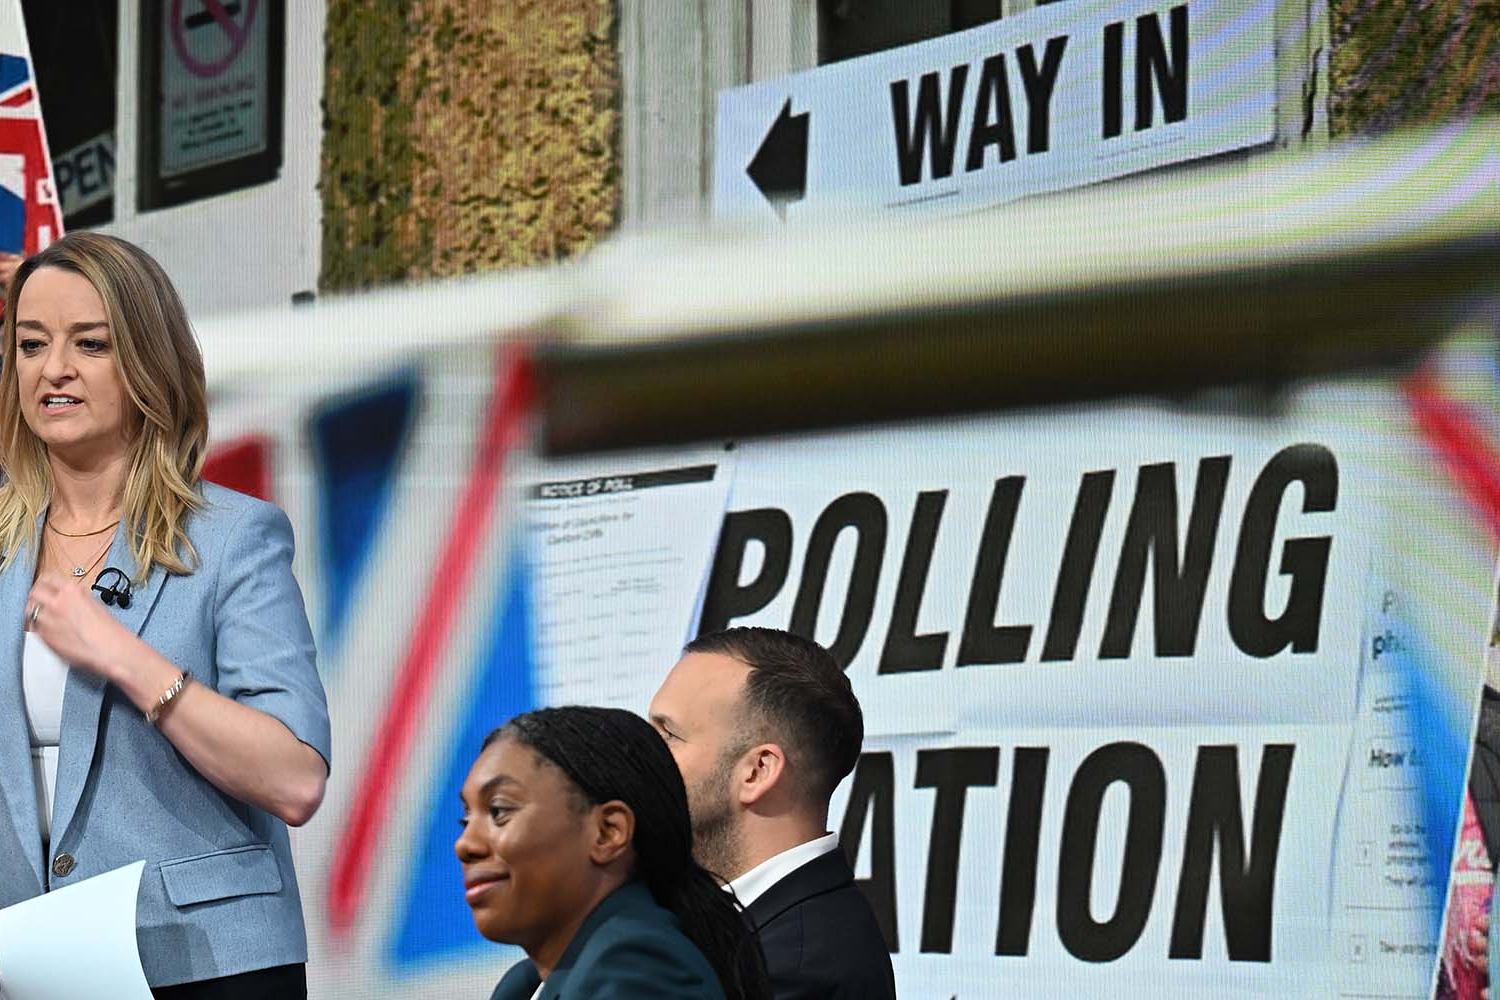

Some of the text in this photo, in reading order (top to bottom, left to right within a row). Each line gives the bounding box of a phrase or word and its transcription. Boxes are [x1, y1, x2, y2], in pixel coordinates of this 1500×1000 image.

[890, 4, 1188, 188] WAY IN
[698, 442, 1339, 675] POLLING
[840, 741, 1296, 963] ATION
